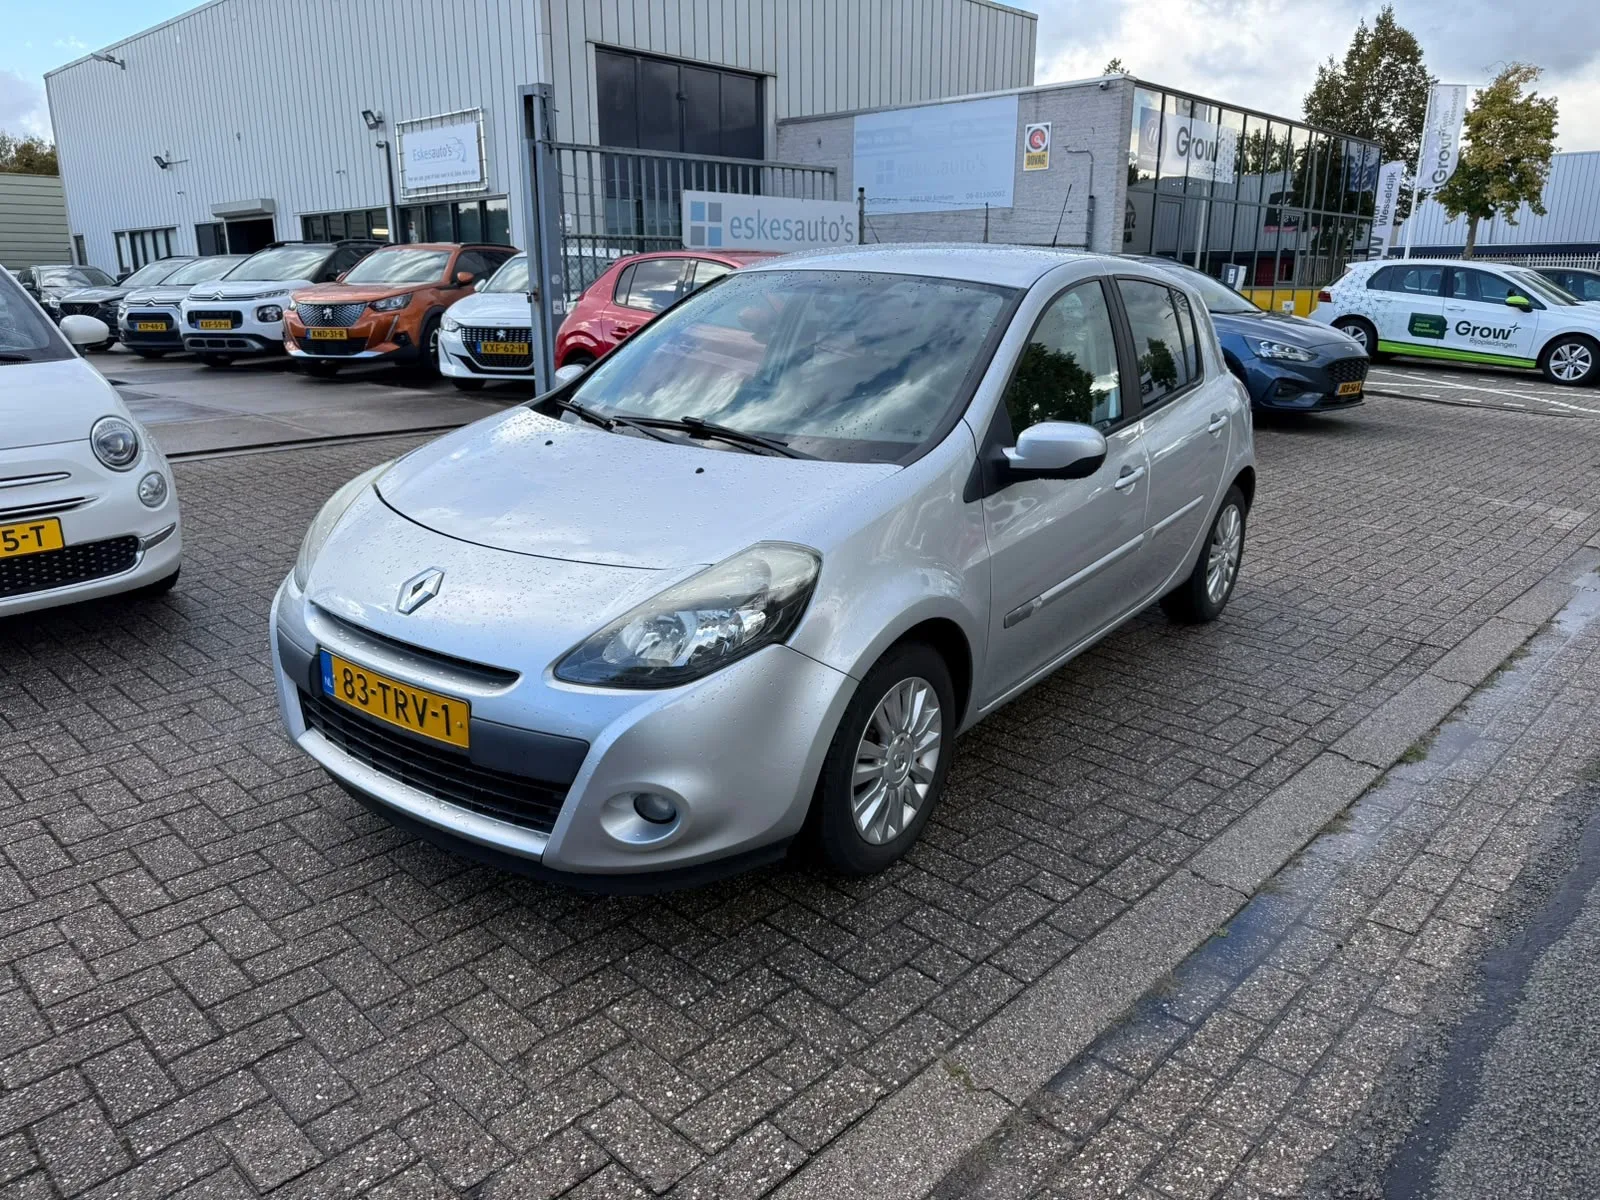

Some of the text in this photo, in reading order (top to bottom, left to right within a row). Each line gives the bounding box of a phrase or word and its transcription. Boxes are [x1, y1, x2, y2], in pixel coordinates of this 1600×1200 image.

[412, 143, 453, 161] Eskesauto's
[1176, 126, 1217, 162] Grow
[1378, 171, 1397, 227] Wesseldijk
[729, 208, 854, 243] eskesauto's
[1455, 320, 1512, 340] Grow
[483, 343, 525, 353] KXF-62-H
[1469, 337, 1518, 349] Rijopleidingen
[2, 525, 45, 551] 5-T
[324, 675, 333, 688] NL
[343, 667, 451, 736] 83-TRV-1
